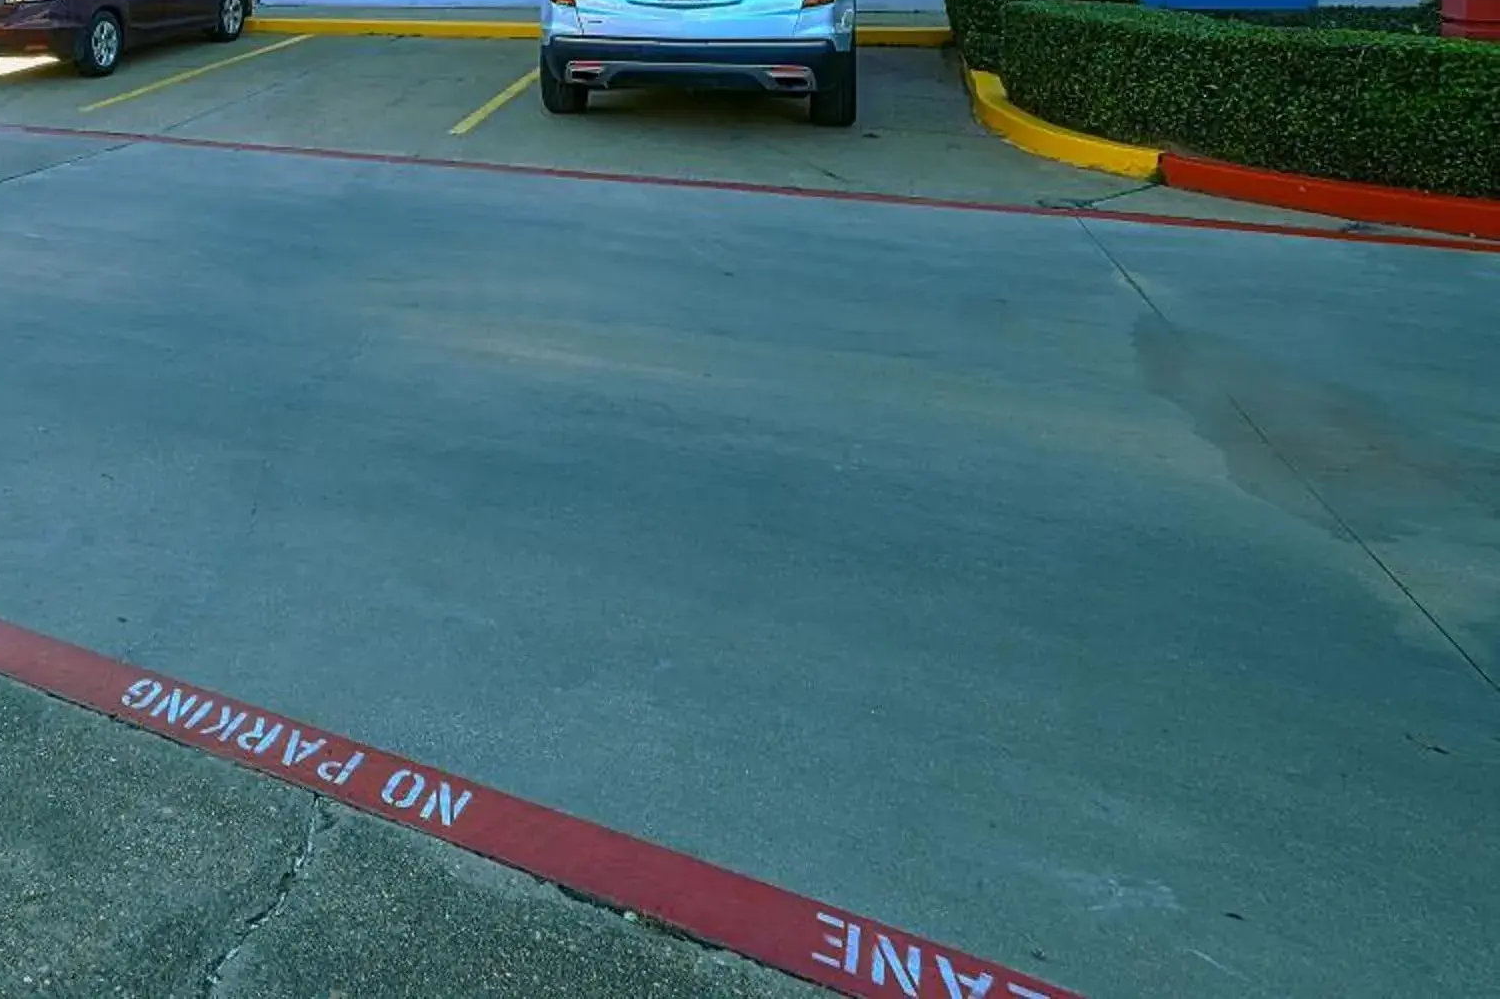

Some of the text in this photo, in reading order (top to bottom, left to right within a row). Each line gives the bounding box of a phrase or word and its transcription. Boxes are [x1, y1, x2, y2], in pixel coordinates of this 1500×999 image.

[121, 678, 472, 826] NO PARKING
[811, 912, 1050, 999] ANE
